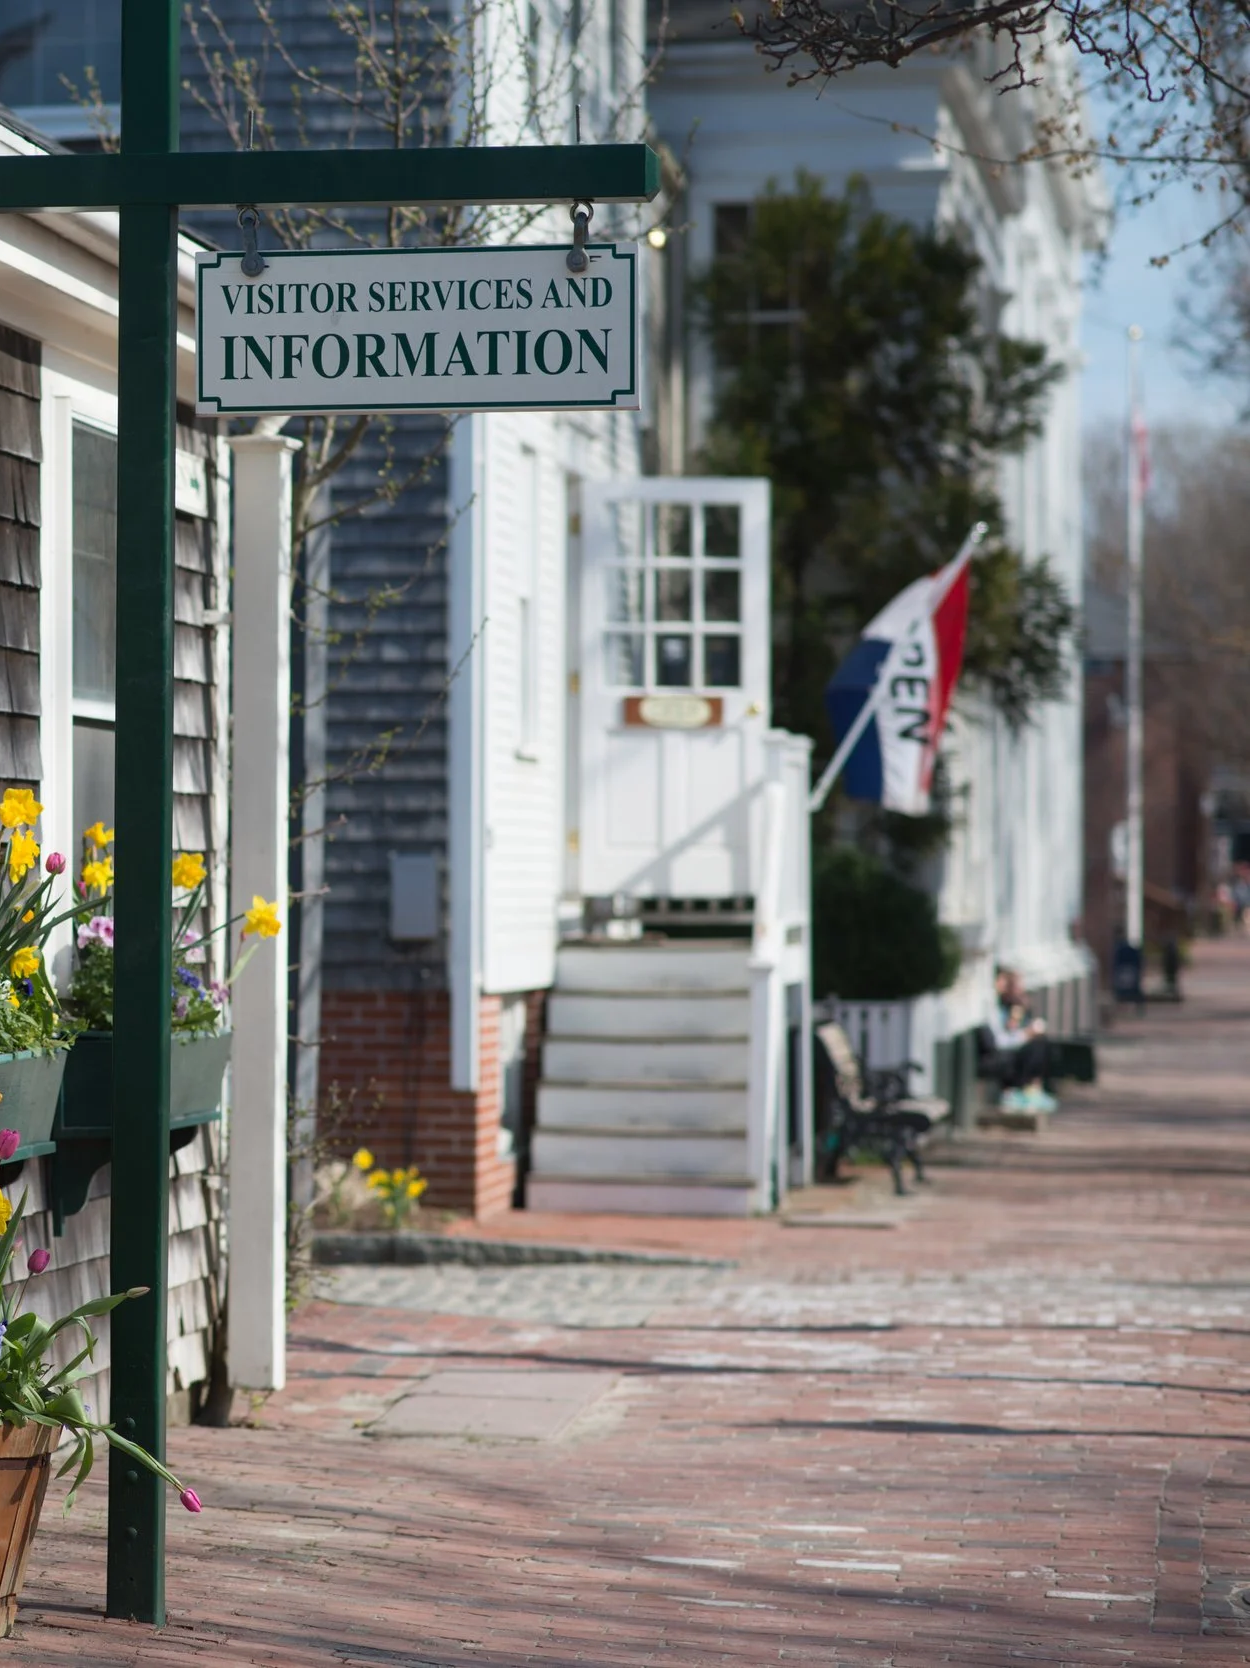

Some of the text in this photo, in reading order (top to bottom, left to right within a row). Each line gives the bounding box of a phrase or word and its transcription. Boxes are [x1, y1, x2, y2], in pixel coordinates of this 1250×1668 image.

[220, 276, 613, 315] VISITOR SERVICES AND
[219, 328, 613, 380] INFORMATION
